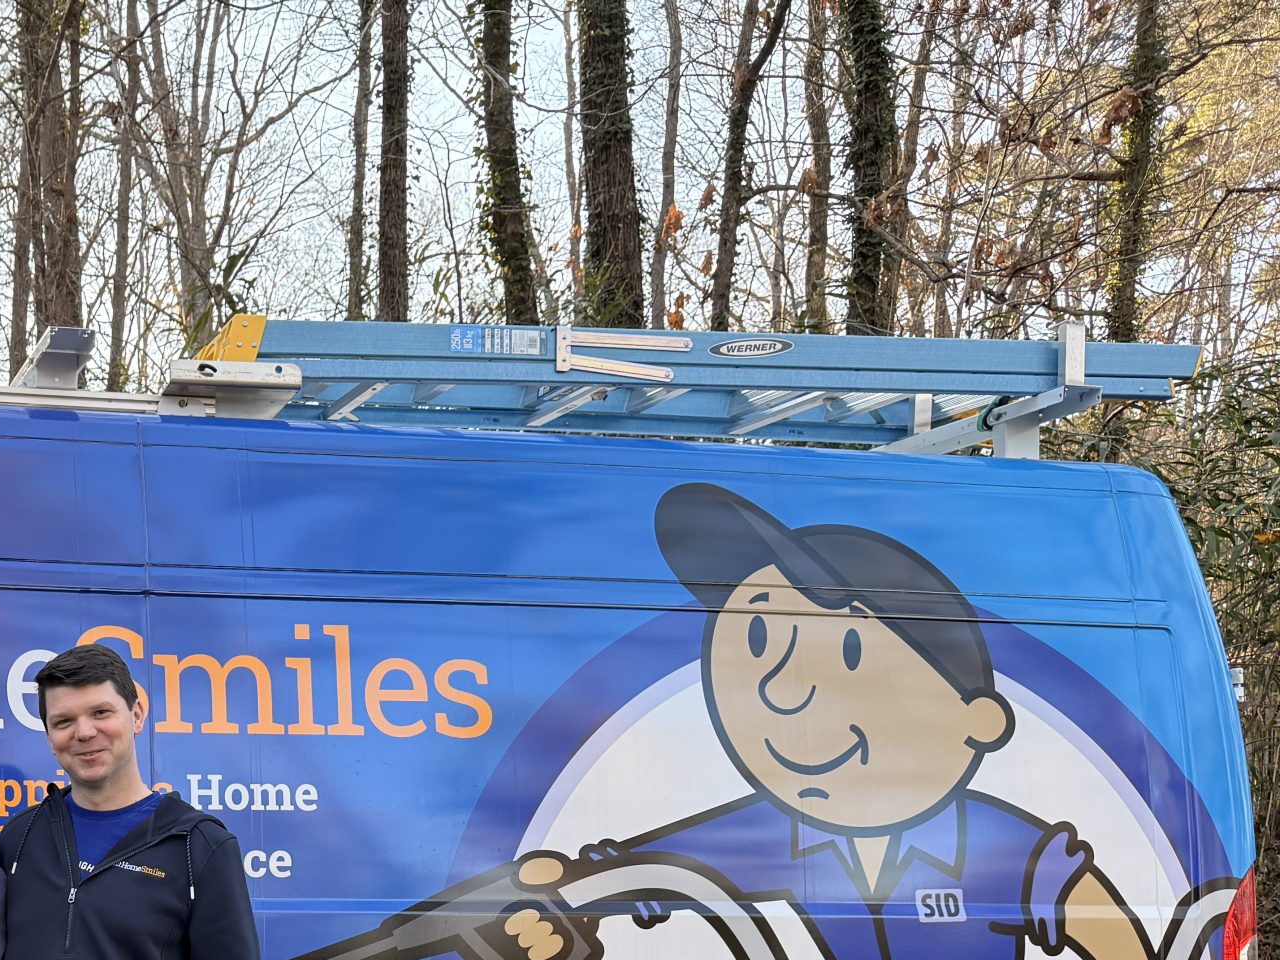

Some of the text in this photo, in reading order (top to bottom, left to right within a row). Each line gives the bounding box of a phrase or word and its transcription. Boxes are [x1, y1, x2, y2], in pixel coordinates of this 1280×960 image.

[726, 342, 777, 354] WERNER
[186, 774, 319, 811] Home
[920, 892, 960, 918] SID
